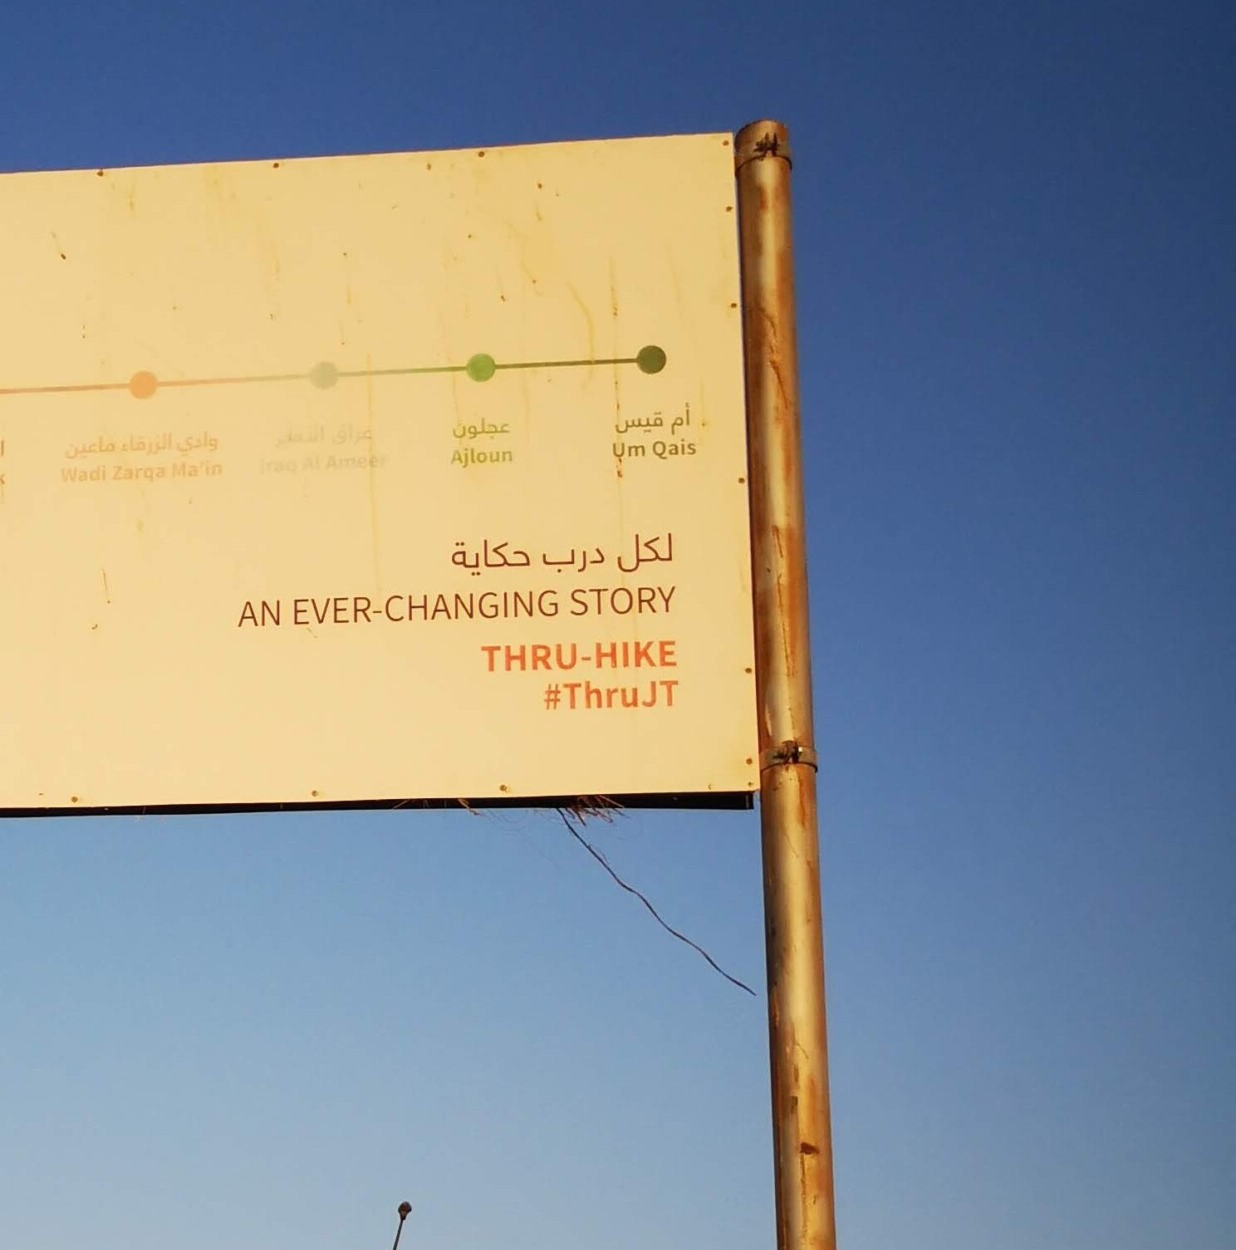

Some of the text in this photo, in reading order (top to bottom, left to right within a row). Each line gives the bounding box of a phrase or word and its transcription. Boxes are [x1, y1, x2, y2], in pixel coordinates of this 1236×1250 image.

[453, 418, 510, 440] عجلون
[615, 403, 690, 434] أم قيس
[66, 431, 218, 459] وادي الزرقاء ماعين
[451, 448, 512, 468] Ajloun
[613, 439, 696, 460] Um Qais
[62, 466, 106, 482] Wadi
[113, 466, 165, 482] Zarqa
[260, 454, 387, 475] Iraq Al Ameer
[452, 533, 672, 576] لكل درب حكاية
[238, 586, 675, 627] AN EVER-CHANGING STORY
[481, 641, 677, 672] THRU-HIKE
[544, 680, 679, 709] #ThruJT
